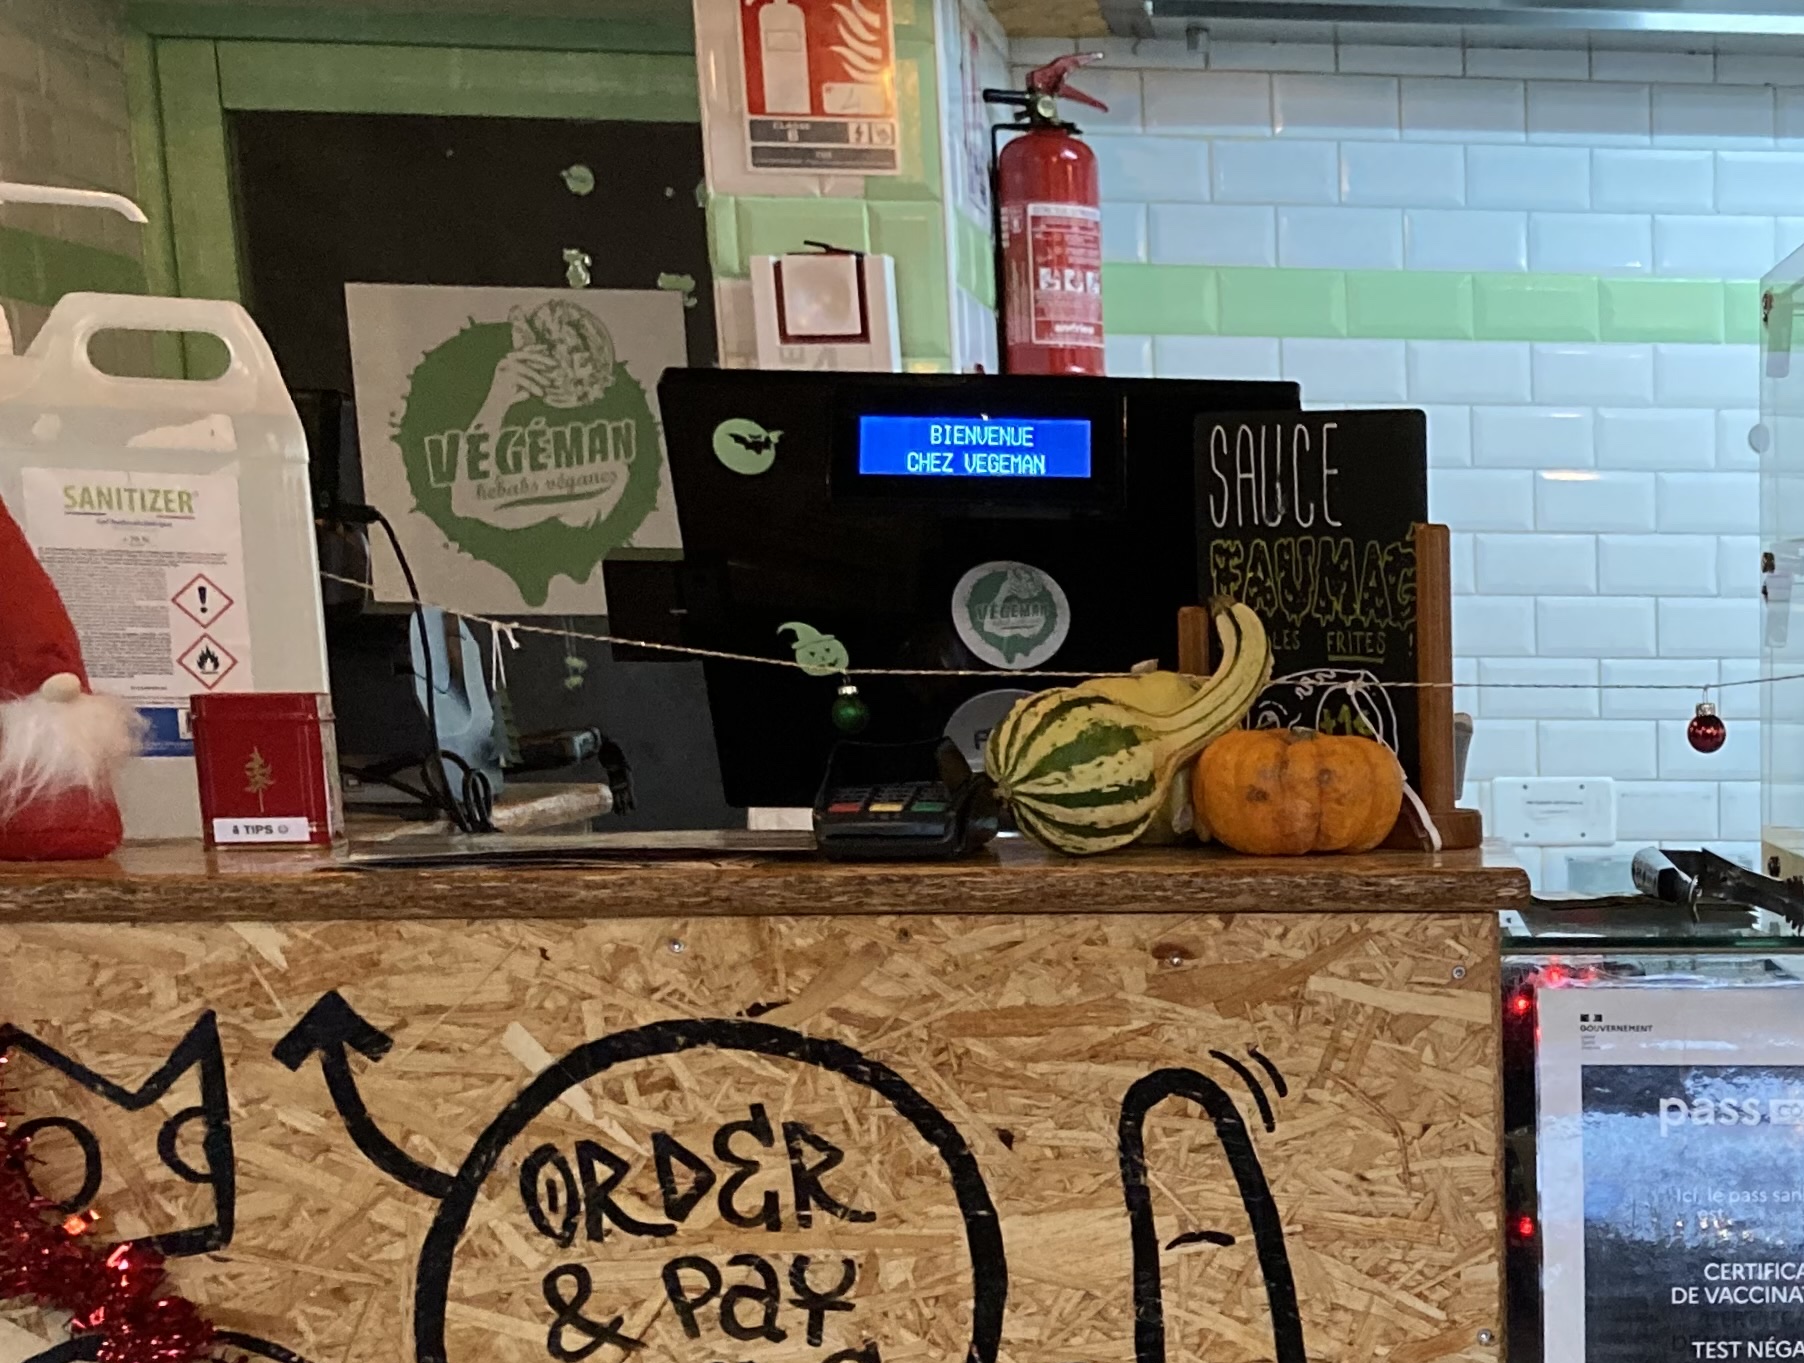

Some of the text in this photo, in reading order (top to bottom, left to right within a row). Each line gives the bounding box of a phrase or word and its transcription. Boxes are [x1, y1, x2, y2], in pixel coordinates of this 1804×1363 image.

[930, 425, 1035, 447] BIENVENUE
[424, 416, 636, 488] VÉGÉMAN
[906, 452, 1046, 475] CHEZ VEGEMAN
[1209, 422, 1342, 528] SAUCE
[63, 485, 195, 514] SANITIZER
[1210, 535, 1417, 630] FAUMAG
[1327, 631, 1387, 654] FRITES
[244, 825, 274, 835] TIPS
[1580, 1024, 1653, 1033] GOUVERNEMENT
[1659, 1095, 1761, 1138] pass
[519, 1102, 877, 1248] ORDER
[1708, 1187, 1723, 1203] le
[1728, 1190, 1767, 1207] pass
[1671, 1286, 1699, 1304] DE
[543, 1264, 648, 1363] &
[1692, 1340, 1742, 1359] TEST
